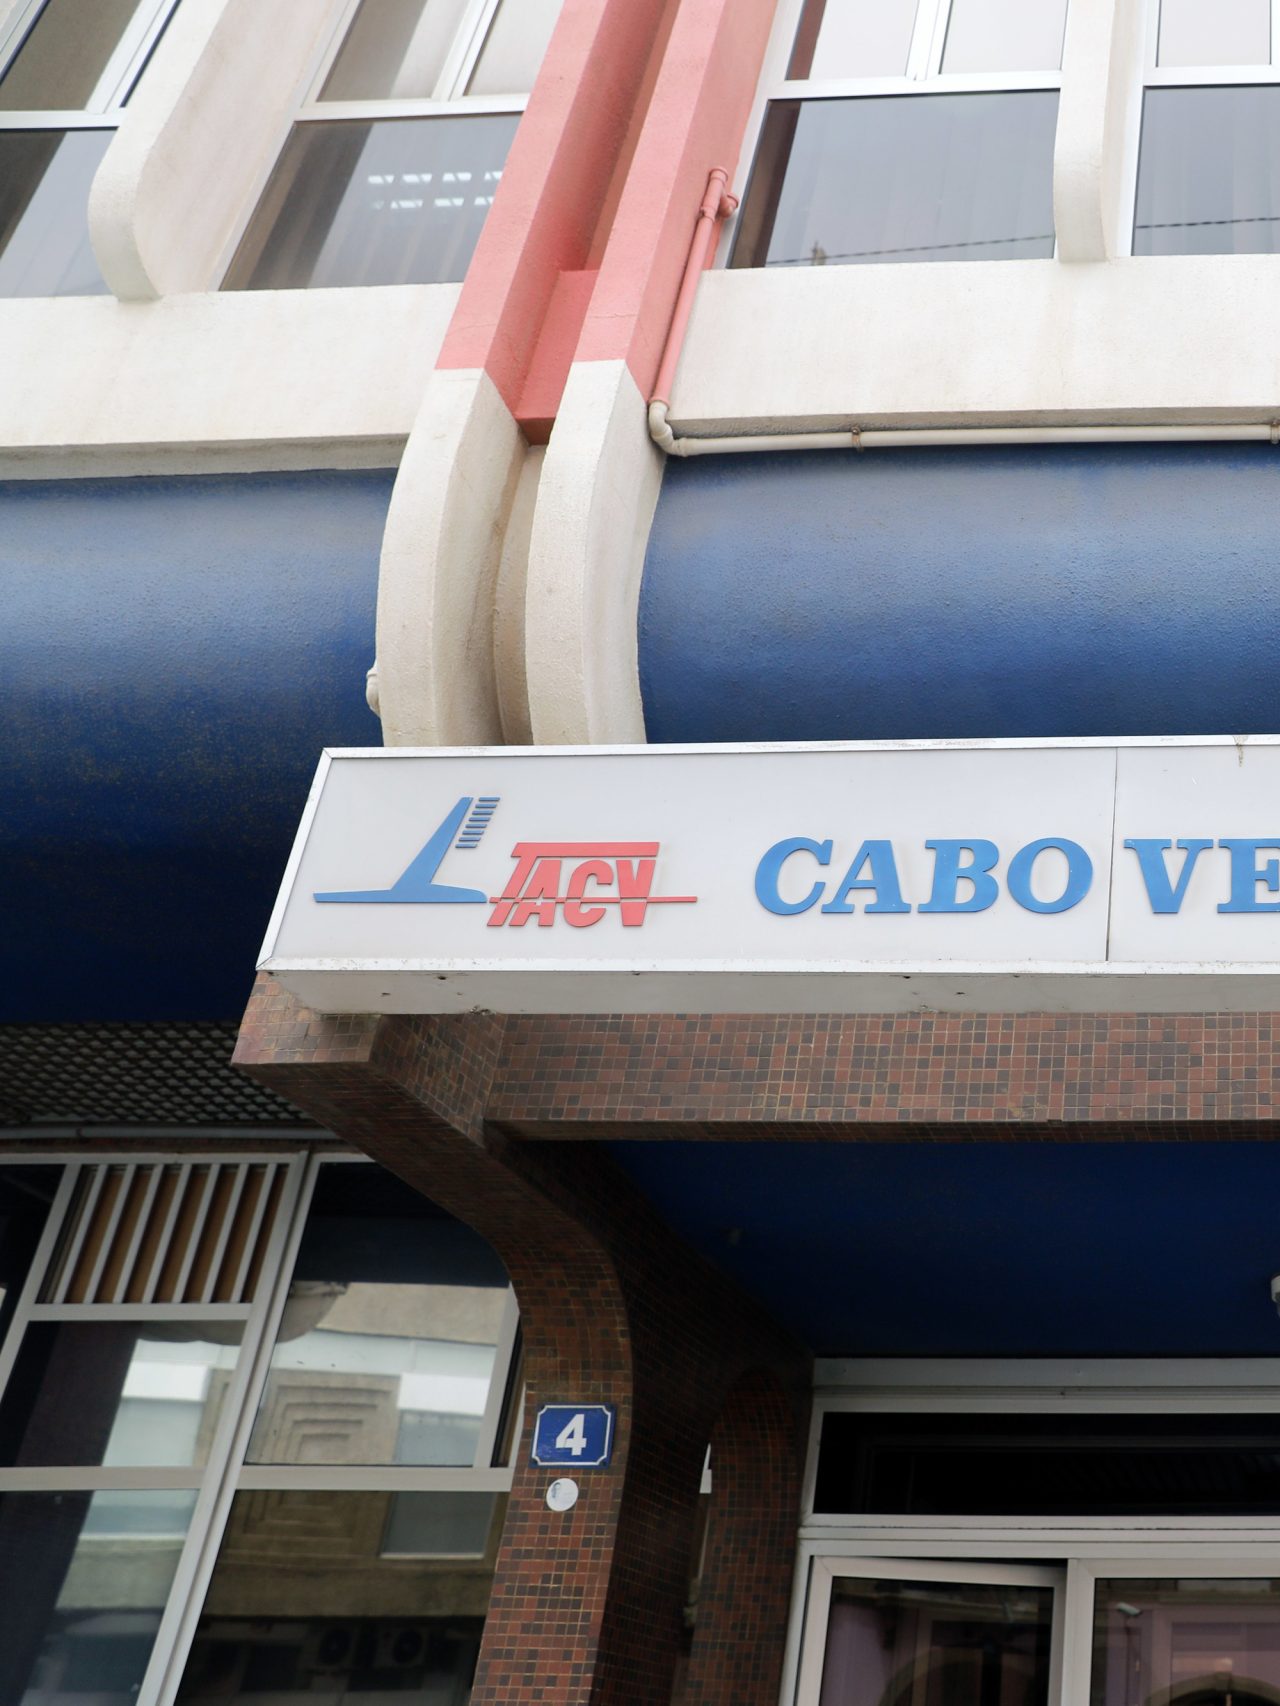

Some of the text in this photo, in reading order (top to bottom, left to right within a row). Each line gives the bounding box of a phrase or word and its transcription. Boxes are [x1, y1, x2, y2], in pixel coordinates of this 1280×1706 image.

[487, 842, 660, 928] TACV
[755, 837, 1092, 915] CABO
[555, 1413, 587, 1456] 4
